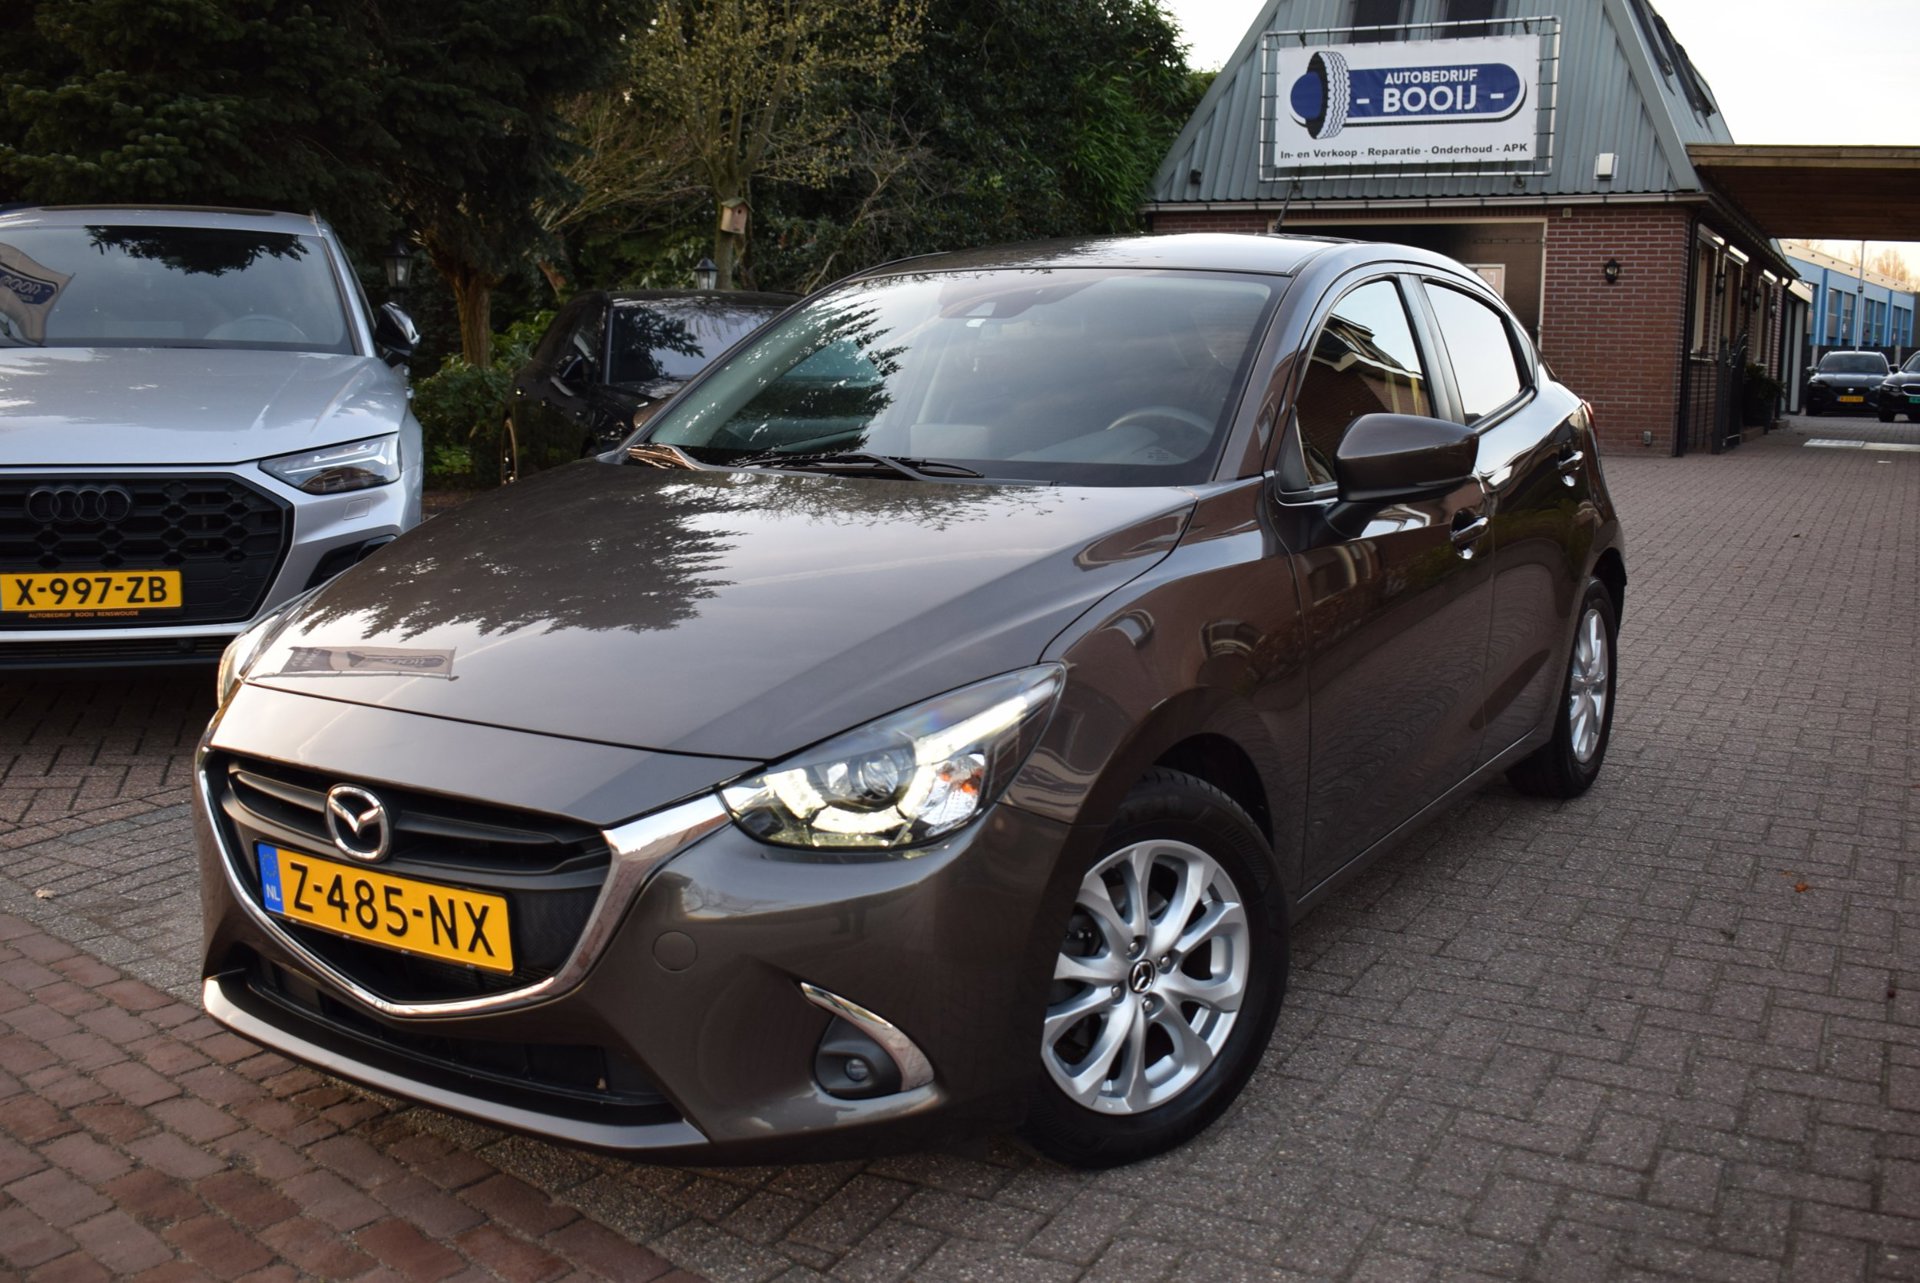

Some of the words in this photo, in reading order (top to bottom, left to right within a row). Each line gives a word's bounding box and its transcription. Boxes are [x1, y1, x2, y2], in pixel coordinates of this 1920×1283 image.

[1385, 69, 1478, 85] AUTOBEDRIJF
[1383, 86, 1477, 113] BOOIJ
[1280, 151, 1294, 159] In-
[1313, 149, 1357, 160] Verkoop
[1368, 146, 1421, 158] Reparatie
[1431, 144, 1493, 154] Onderhoud
[1503, 143, 1528, 153] APK
[16, 577, 167, 606] X-997-ZB
[266, 883, 281, 901] NL
[290, 862, 495, 957] Z-485-NX
